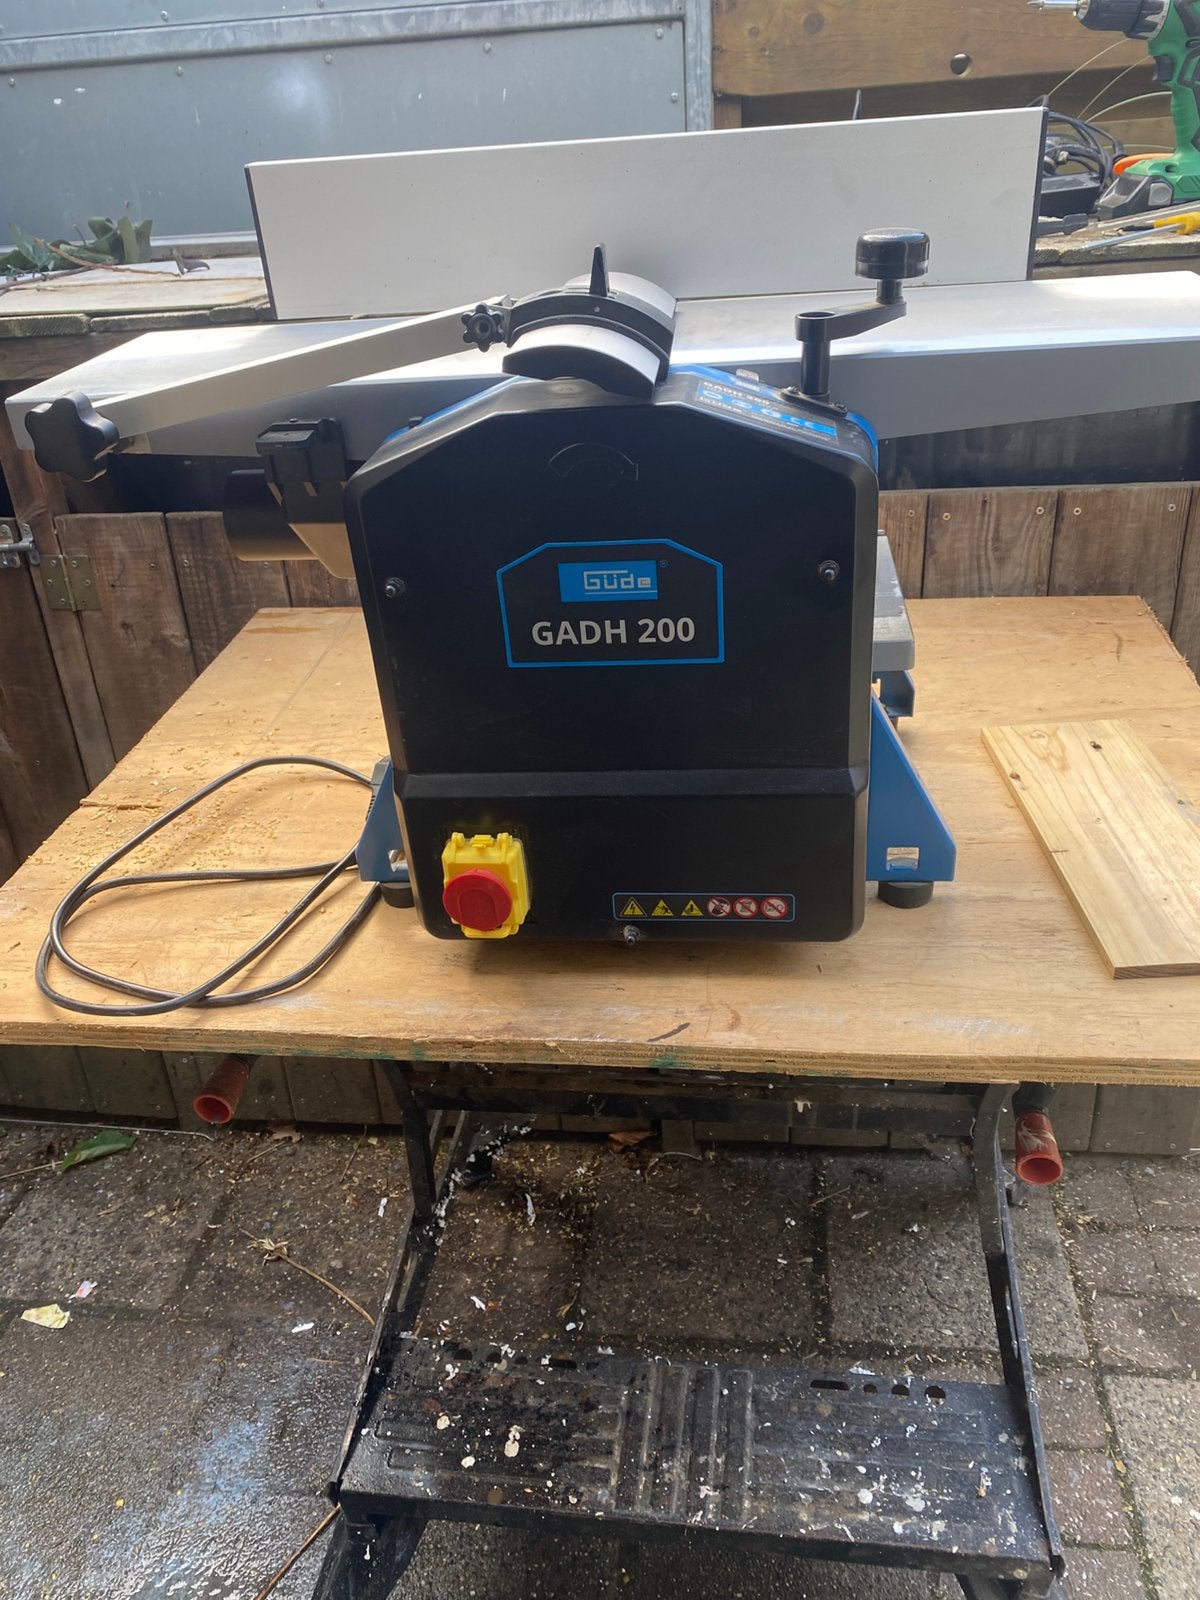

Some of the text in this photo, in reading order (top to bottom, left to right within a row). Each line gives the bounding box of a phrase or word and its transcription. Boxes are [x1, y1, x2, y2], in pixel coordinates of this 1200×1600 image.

[583, 569, 652, 590] Güde
[531, 617, 696, 645] GADH 200
